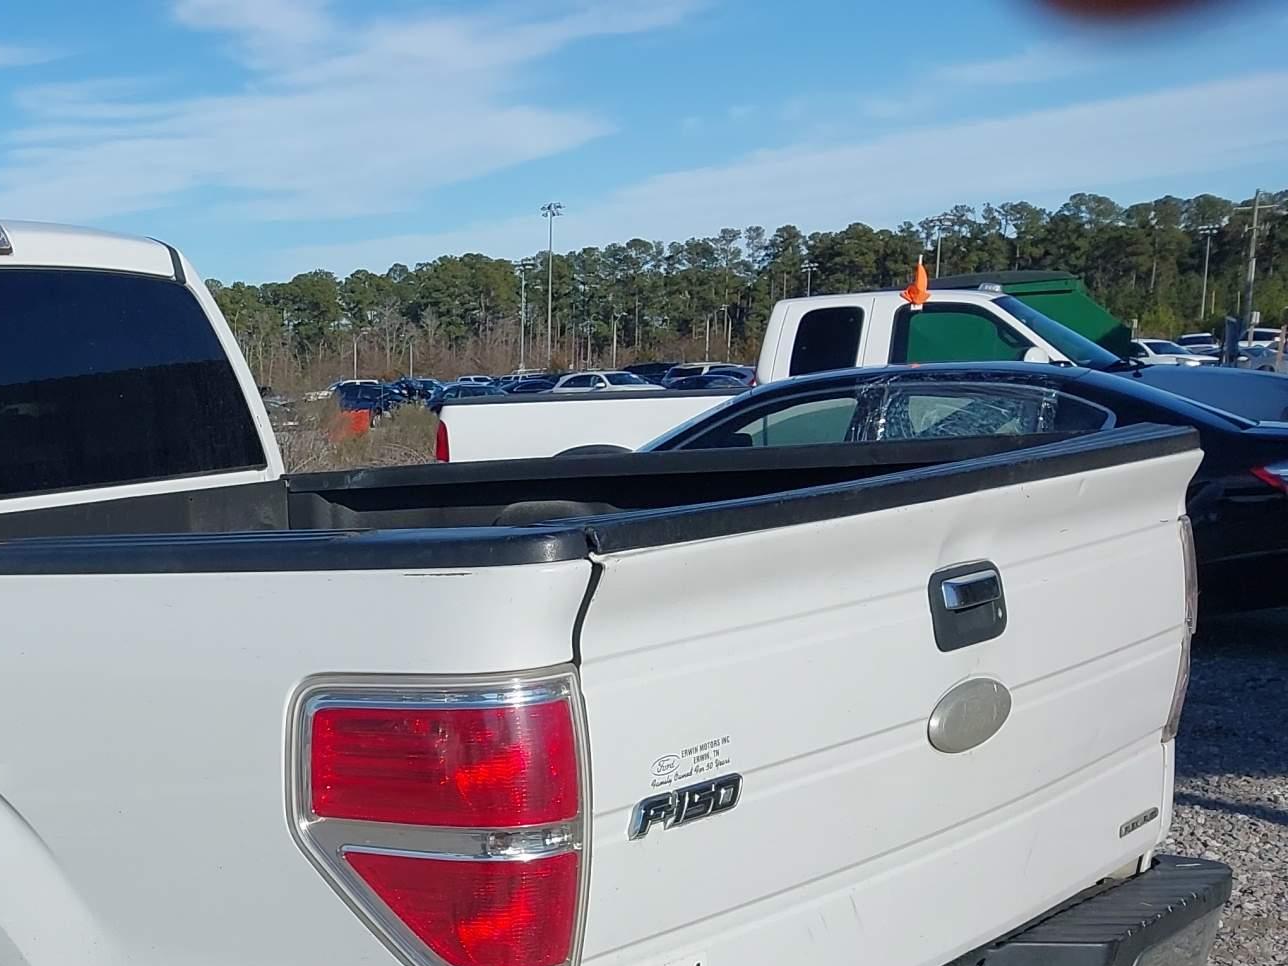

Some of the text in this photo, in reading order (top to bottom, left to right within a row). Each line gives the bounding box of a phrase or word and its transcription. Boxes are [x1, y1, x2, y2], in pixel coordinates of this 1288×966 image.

[681, 736, 730, 758] ERWIN MOTORS INC
[713, 749, 720, 757] TN
